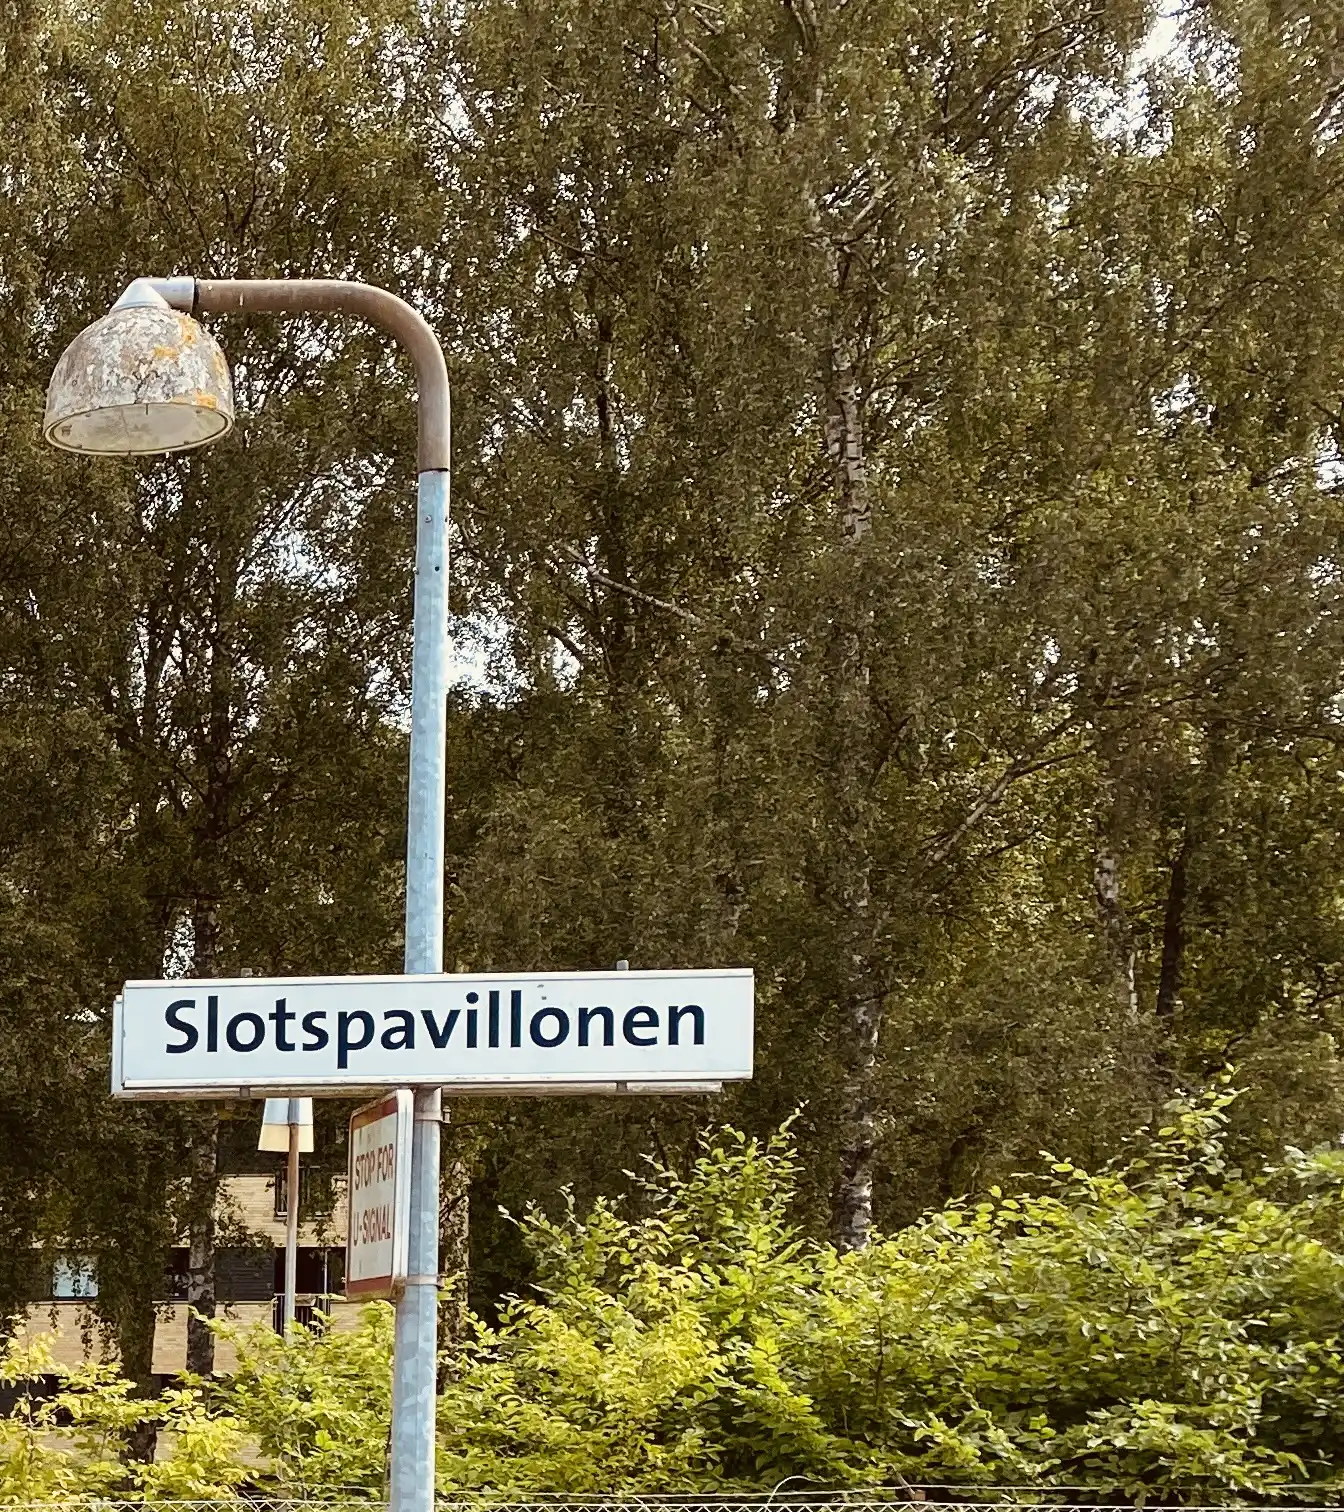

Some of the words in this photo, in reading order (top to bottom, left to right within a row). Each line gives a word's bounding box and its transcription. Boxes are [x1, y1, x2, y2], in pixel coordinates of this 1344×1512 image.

[165, 989, 705, 1070] Slotspavillonen
[355, 1149, 376, 1191] STOP
[377, 1143, 394, 1184] FOR
[353, 1203, 391, 1247] U-SIGNAL
